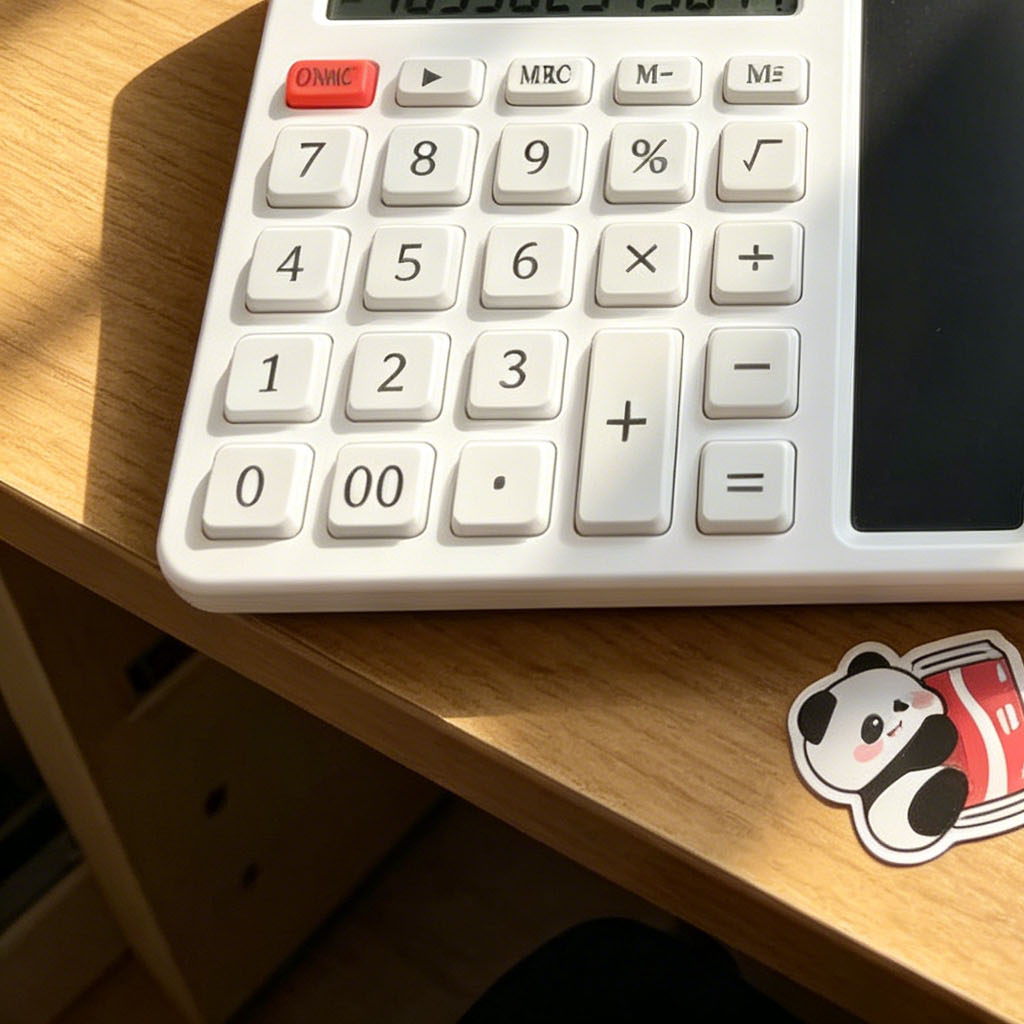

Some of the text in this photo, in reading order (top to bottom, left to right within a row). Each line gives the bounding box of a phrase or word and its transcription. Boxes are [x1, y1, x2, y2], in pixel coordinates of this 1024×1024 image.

[299, 141, 327, 179] 7
[410, 139, 438, 177] 8
[523, 138, 550, 175] 9
[275, 244, 305, 283] 4
[394, 242, 423, 282] 5
[511, 241, 540, 280] 6
[258, 352, 280, 394] 1
[376, 351, 408, 394] 2
[498, 348, 528, 390] 3
[234, 464, 266, 509] 0
[342, 464, 405, 509] 00
